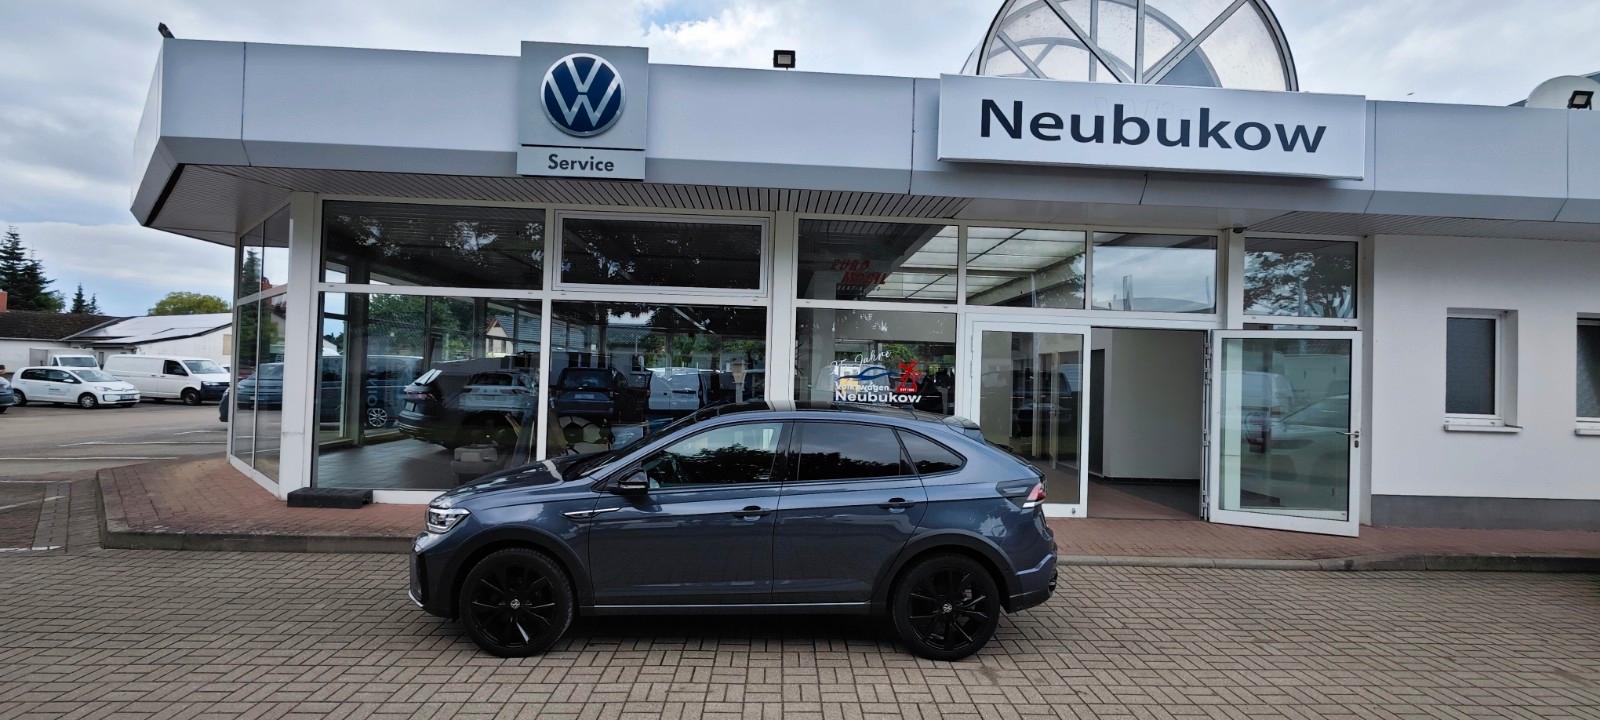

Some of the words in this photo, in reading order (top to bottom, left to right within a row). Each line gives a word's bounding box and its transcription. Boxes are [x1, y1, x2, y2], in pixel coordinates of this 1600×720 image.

[544, 54, 622, 131] VW
[980, 98, 1327, 153] Neubukow
[548, 154, 614, 172] Service
[835, 390, 922, 403] Neubukow
